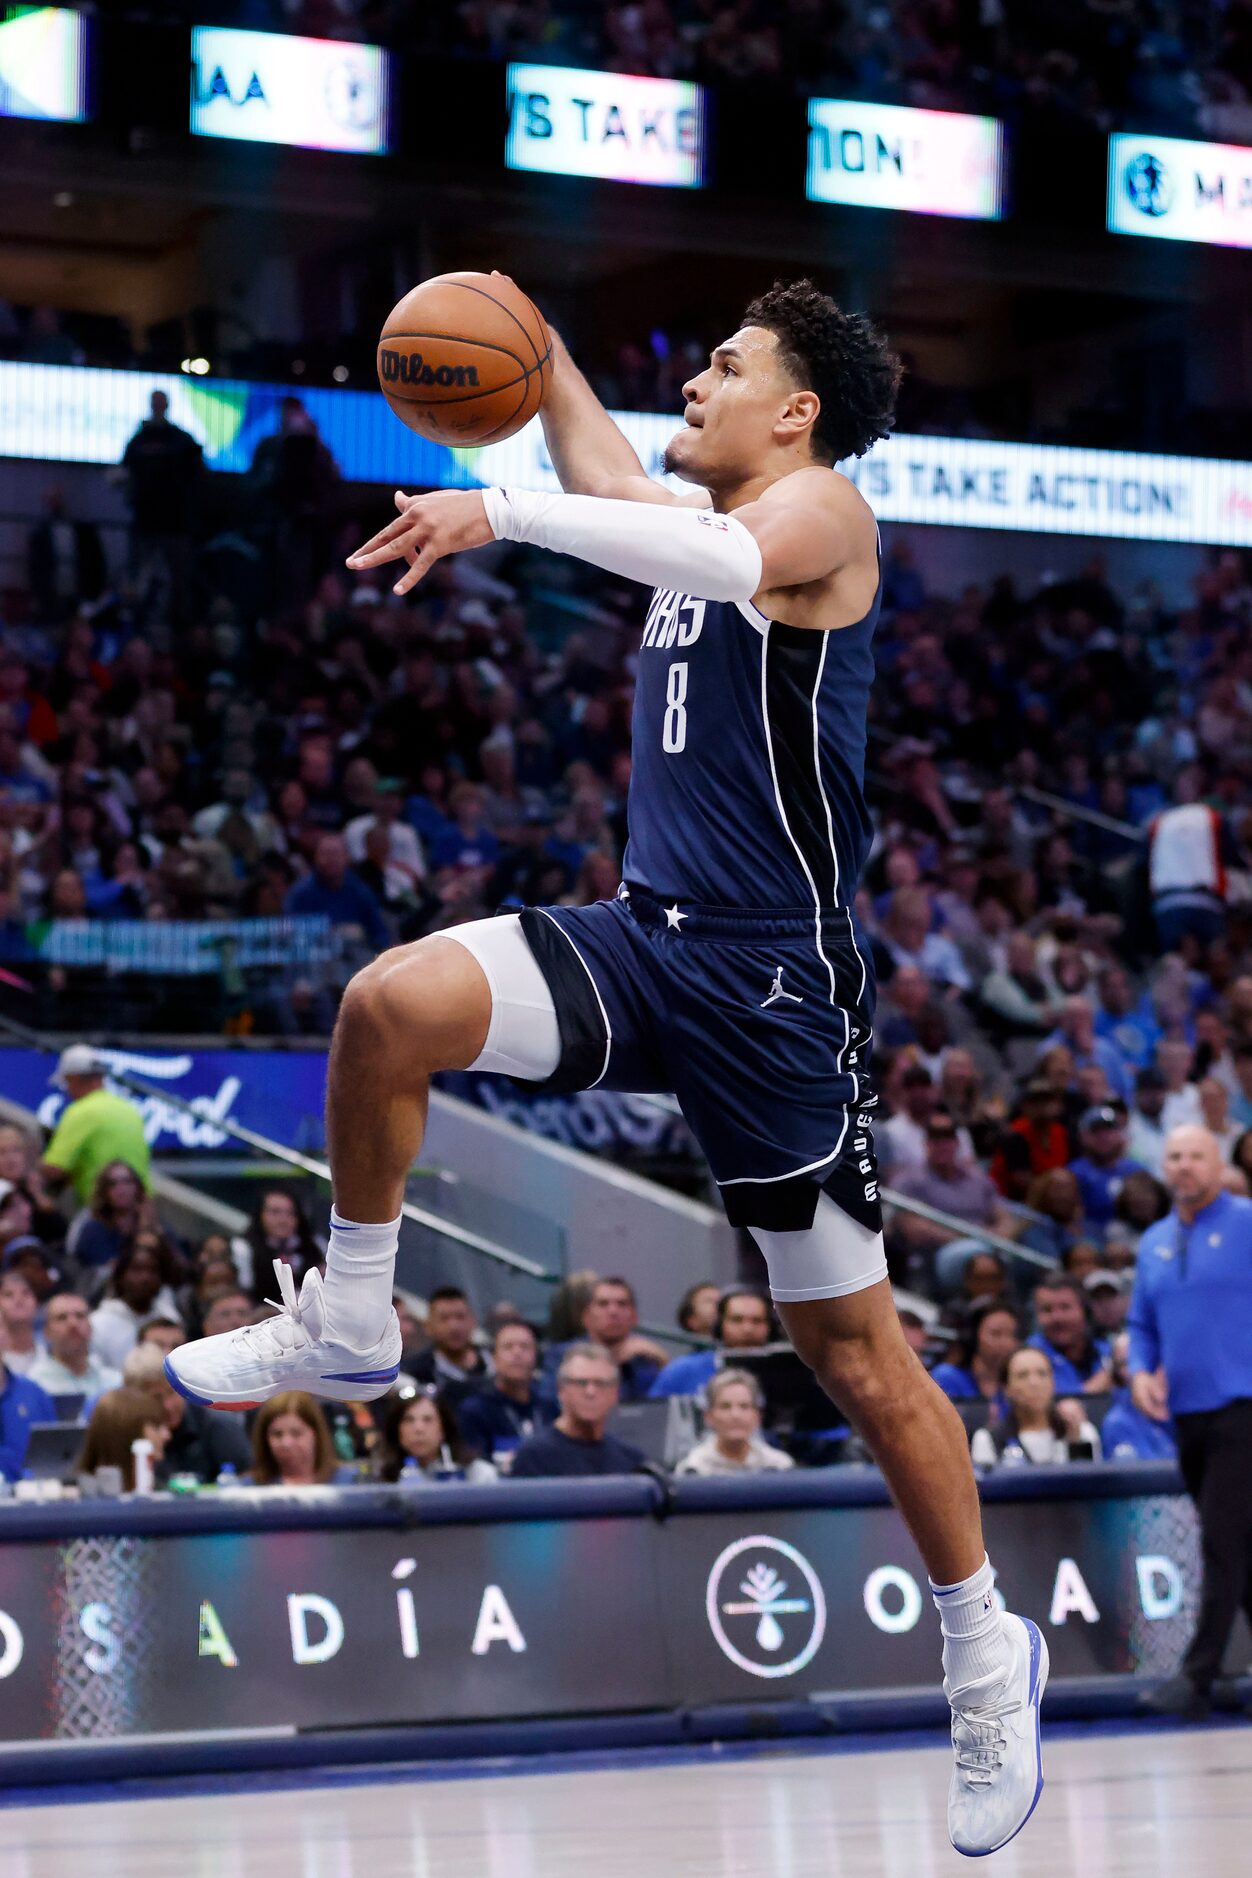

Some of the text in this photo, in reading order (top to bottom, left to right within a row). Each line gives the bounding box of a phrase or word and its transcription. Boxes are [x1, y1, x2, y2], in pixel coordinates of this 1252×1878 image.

[571, 97, 699, 159] TAKE
[380, 348, 480, 387] Wilson
[908, 460, 1009, 506] TAKE
[662, 662, 689, 754] 8
[37, 1050, 242, 1148] Frd
